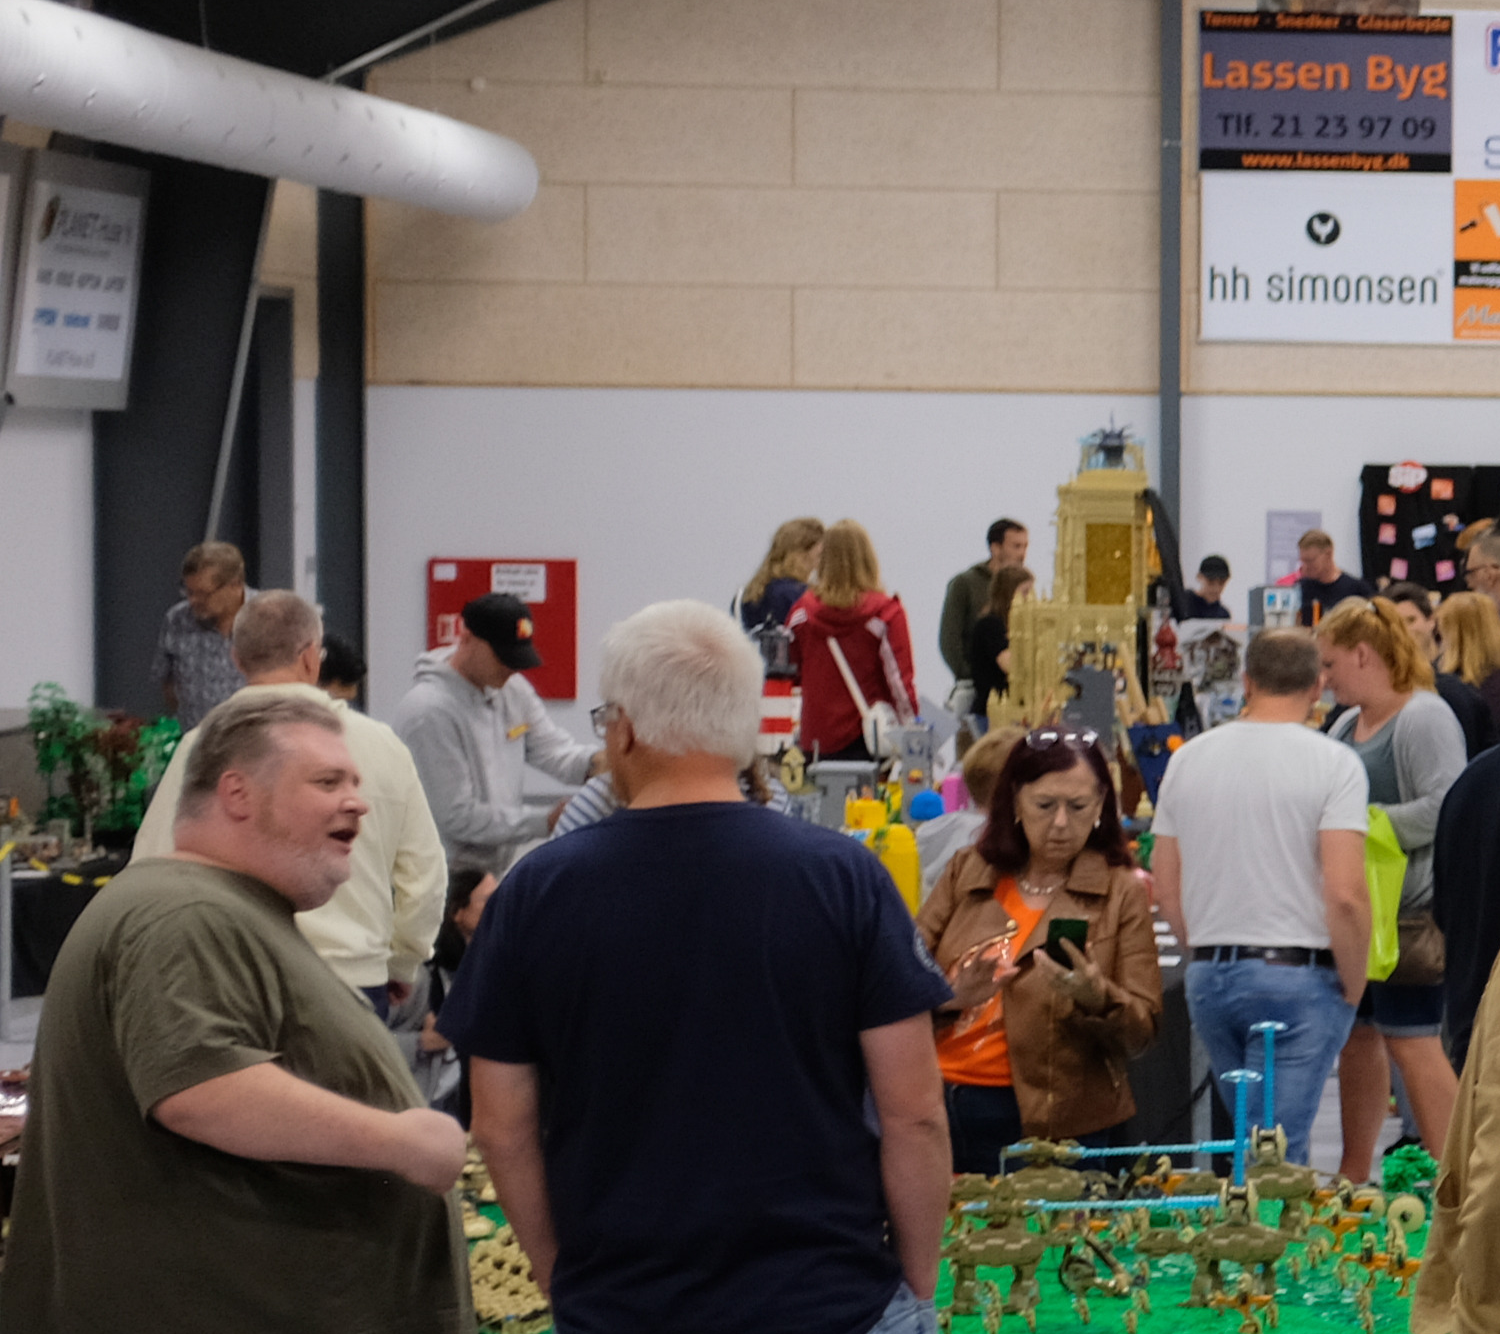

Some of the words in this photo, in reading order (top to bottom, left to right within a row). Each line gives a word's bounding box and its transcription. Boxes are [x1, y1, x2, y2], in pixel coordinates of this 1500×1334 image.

[1202, 51, 1351, 91] Lassen
[1366, 53, 1448, 101] Byg
[1217, 114, 1260, 138] Tlf.
[1270, 116, 1303, 139] 21
[1314, 116, 1348, 139] 23
[1358, 117, 1392, 139] 97
[1402, 117, 1437, 140] 09
[1241, 151, 1410, 171] www.lassenbyg.dk
[1209, 265, 1251, 302] hh
[1267, 267, 1439, 305] simonsen
